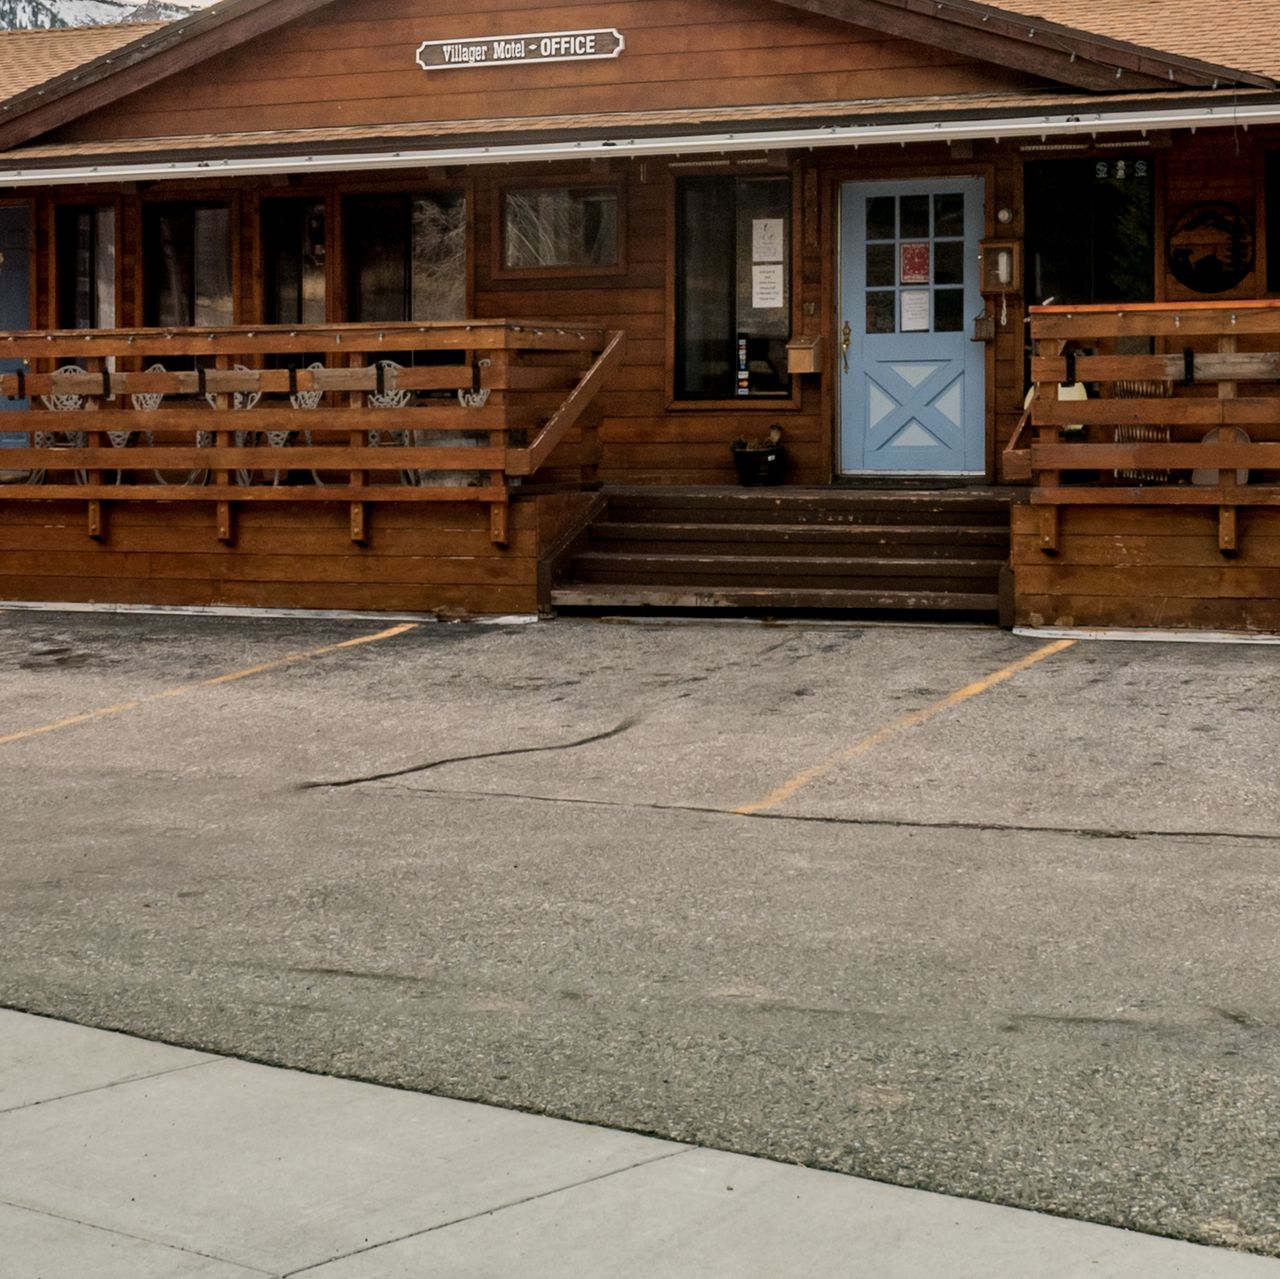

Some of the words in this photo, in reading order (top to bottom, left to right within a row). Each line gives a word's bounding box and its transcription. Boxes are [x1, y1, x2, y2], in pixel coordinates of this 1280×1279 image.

[442, 45, 487, 64] Villager
[493, 41, 525, 59] Motel
[540, 35, 596, 56] OFFICE
